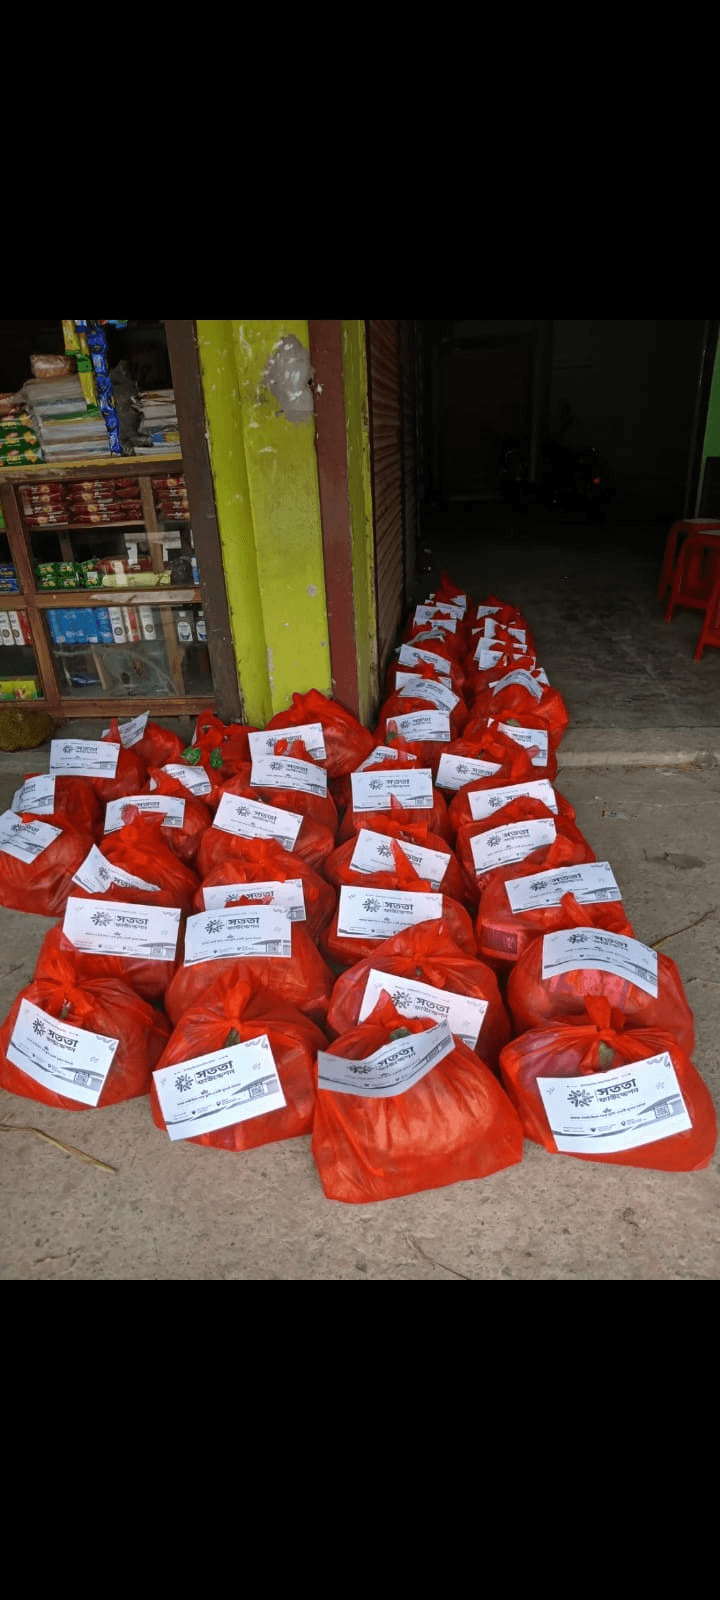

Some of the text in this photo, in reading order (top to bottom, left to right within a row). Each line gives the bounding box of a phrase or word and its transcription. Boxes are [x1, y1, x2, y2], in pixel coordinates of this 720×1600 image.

[384, 902, 413, 910] সততা
[117, 916, 148, 925] সততা
[228, 917, 260, 925] সততা
[416, 998, 450, 1013] সততা
[48, 1029, 79, 1047] সততা
[377, 1046, 414, 1067] সততা
[196, 1061, 233, 1078] সততা
[597, 1078, 637, 1096] সততা
